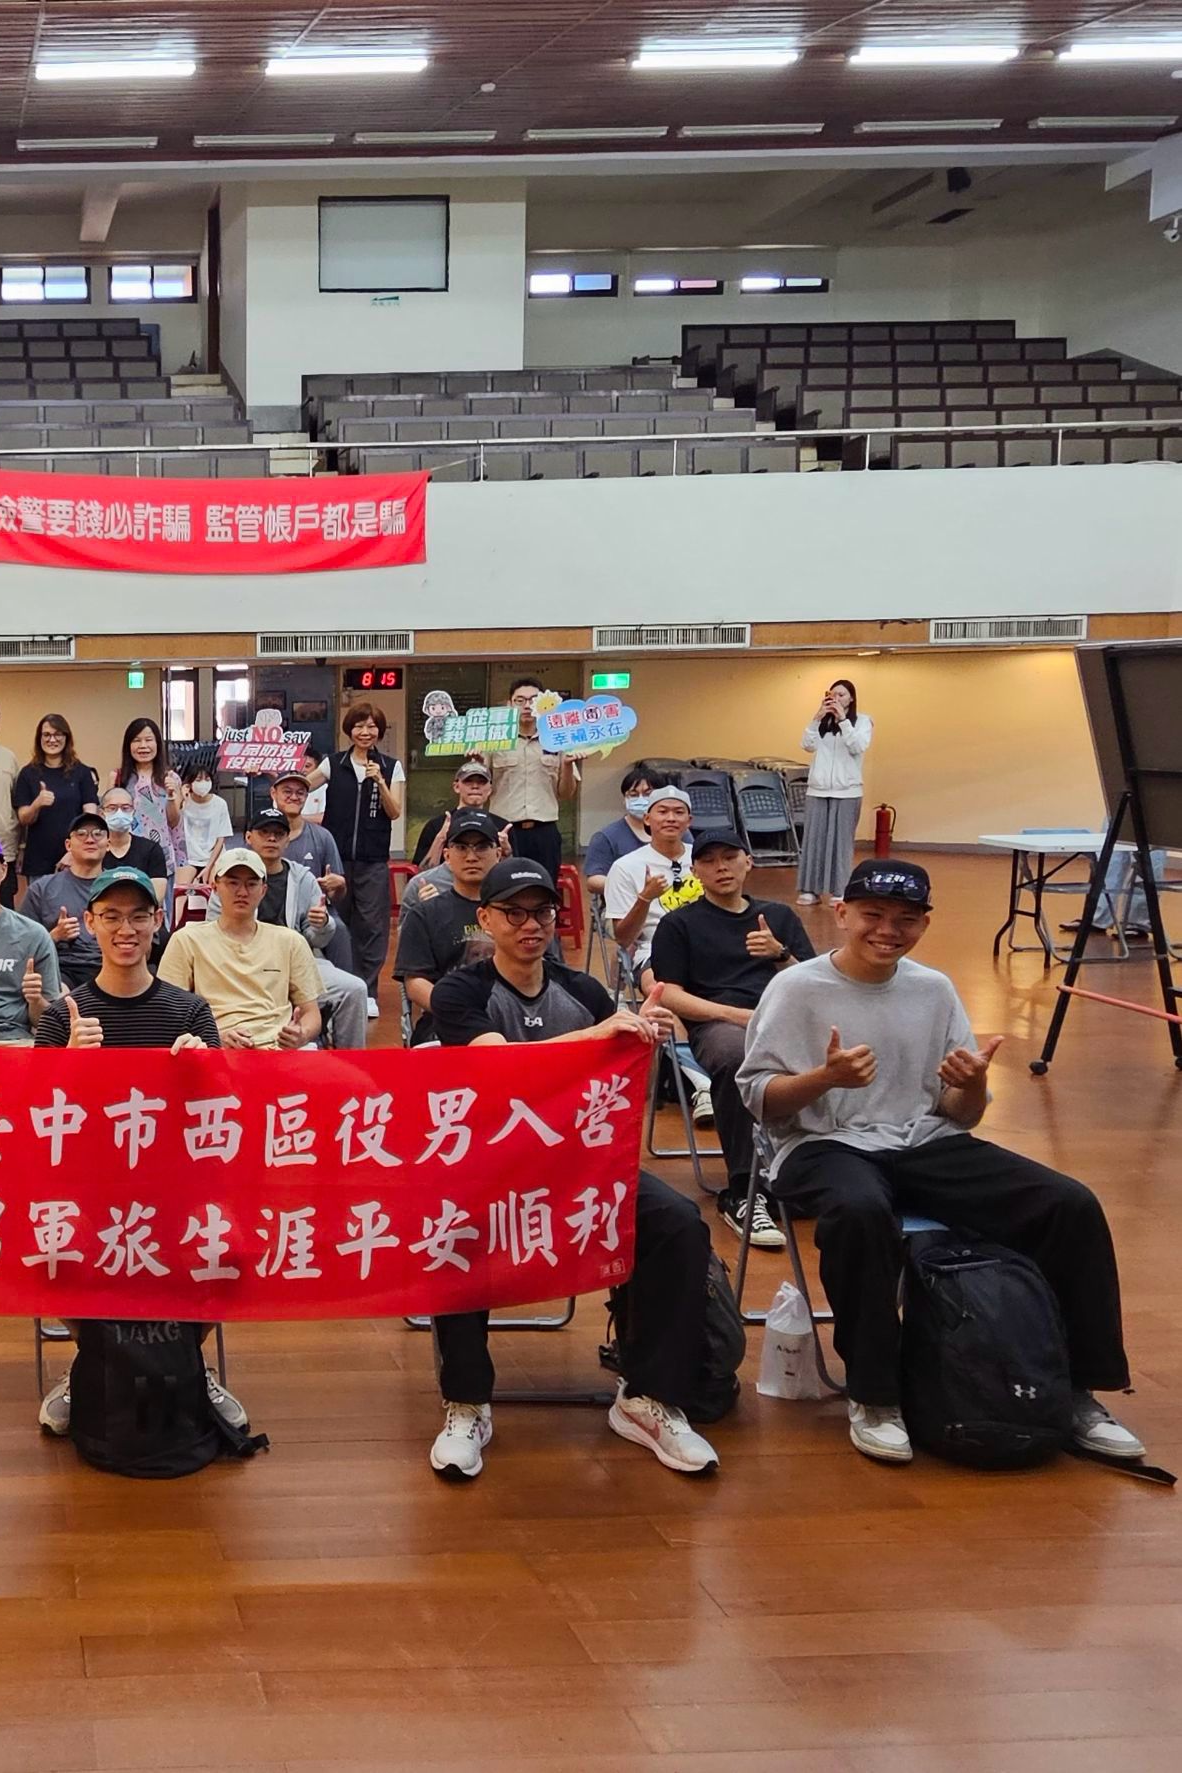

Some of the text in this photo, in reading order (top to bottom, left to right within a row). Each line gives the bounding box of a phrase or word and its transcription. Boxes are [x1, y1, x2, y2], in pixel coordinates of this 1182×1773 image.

[206, 496, 407, 543] 監管帳戶都是騙
[547, 703, 620, 729] 遠離毒害
[223, 726, 310, 744] just NO say
[553, 721, 625, 746] 幸福永在
